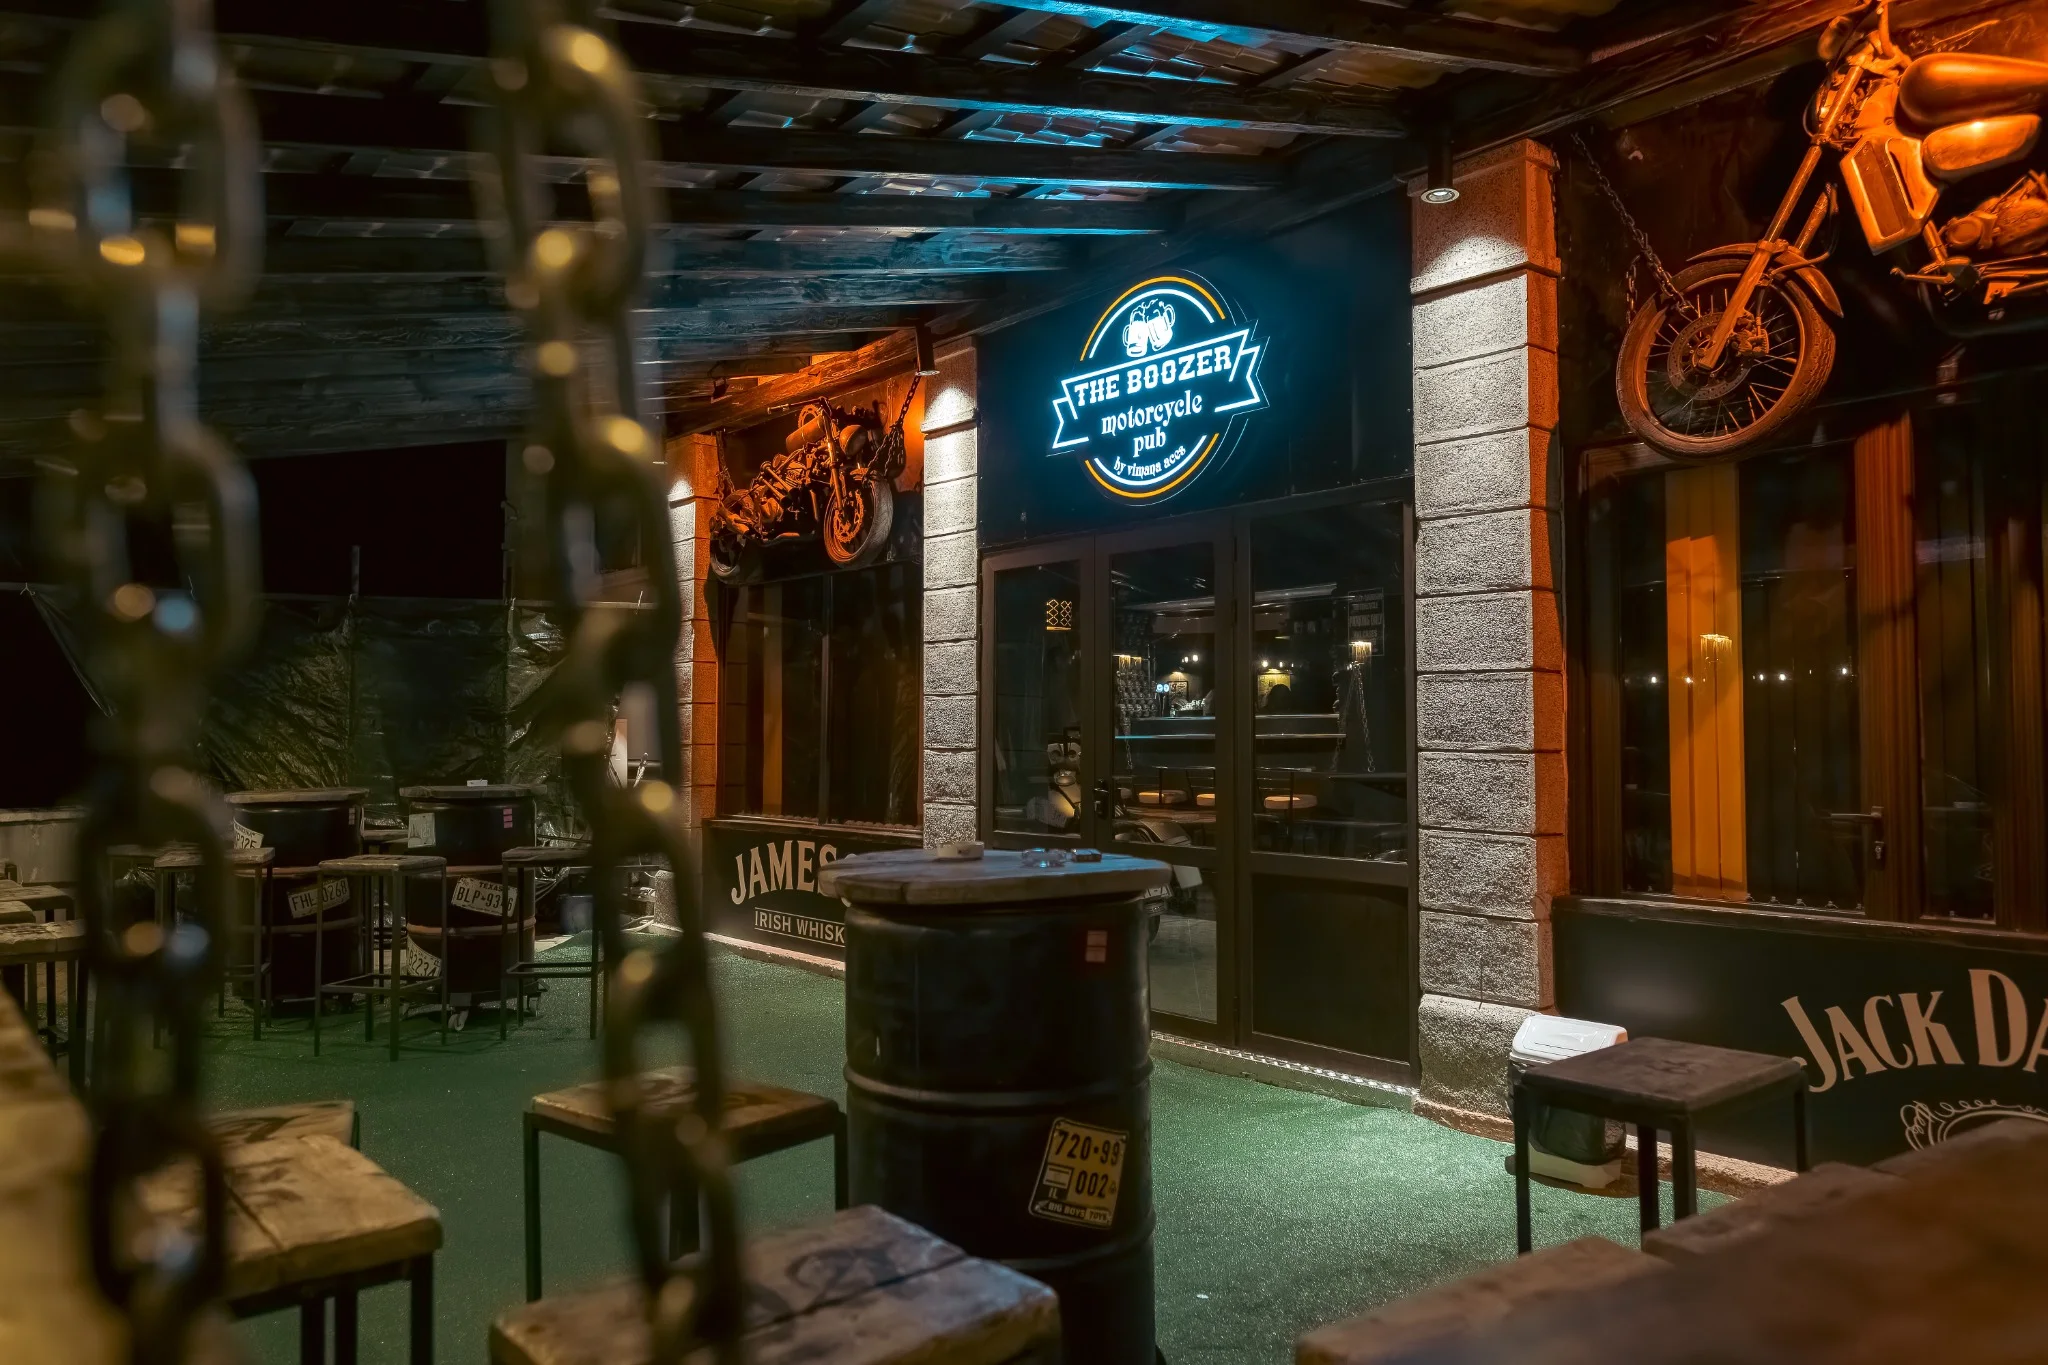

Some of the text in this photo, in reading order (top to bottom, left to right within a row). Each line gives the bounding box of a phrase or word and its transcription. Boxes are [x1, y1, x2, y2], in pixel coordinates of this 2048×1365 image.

[1074, 345, 1232, 407] THE BOOZER
[1101, 390, 1203, 436] motorcycle
[1114, 445, 1186, 480] by vimana aces
[1133, 427, 1167, 458] pub
[731, 840, 855, 904] JAMES
[755, 911, 845, 944] IRISH WHISK
[1780, 990, 1965, 1092] JACK
[1076, 1170, 1109, 1198] 002
